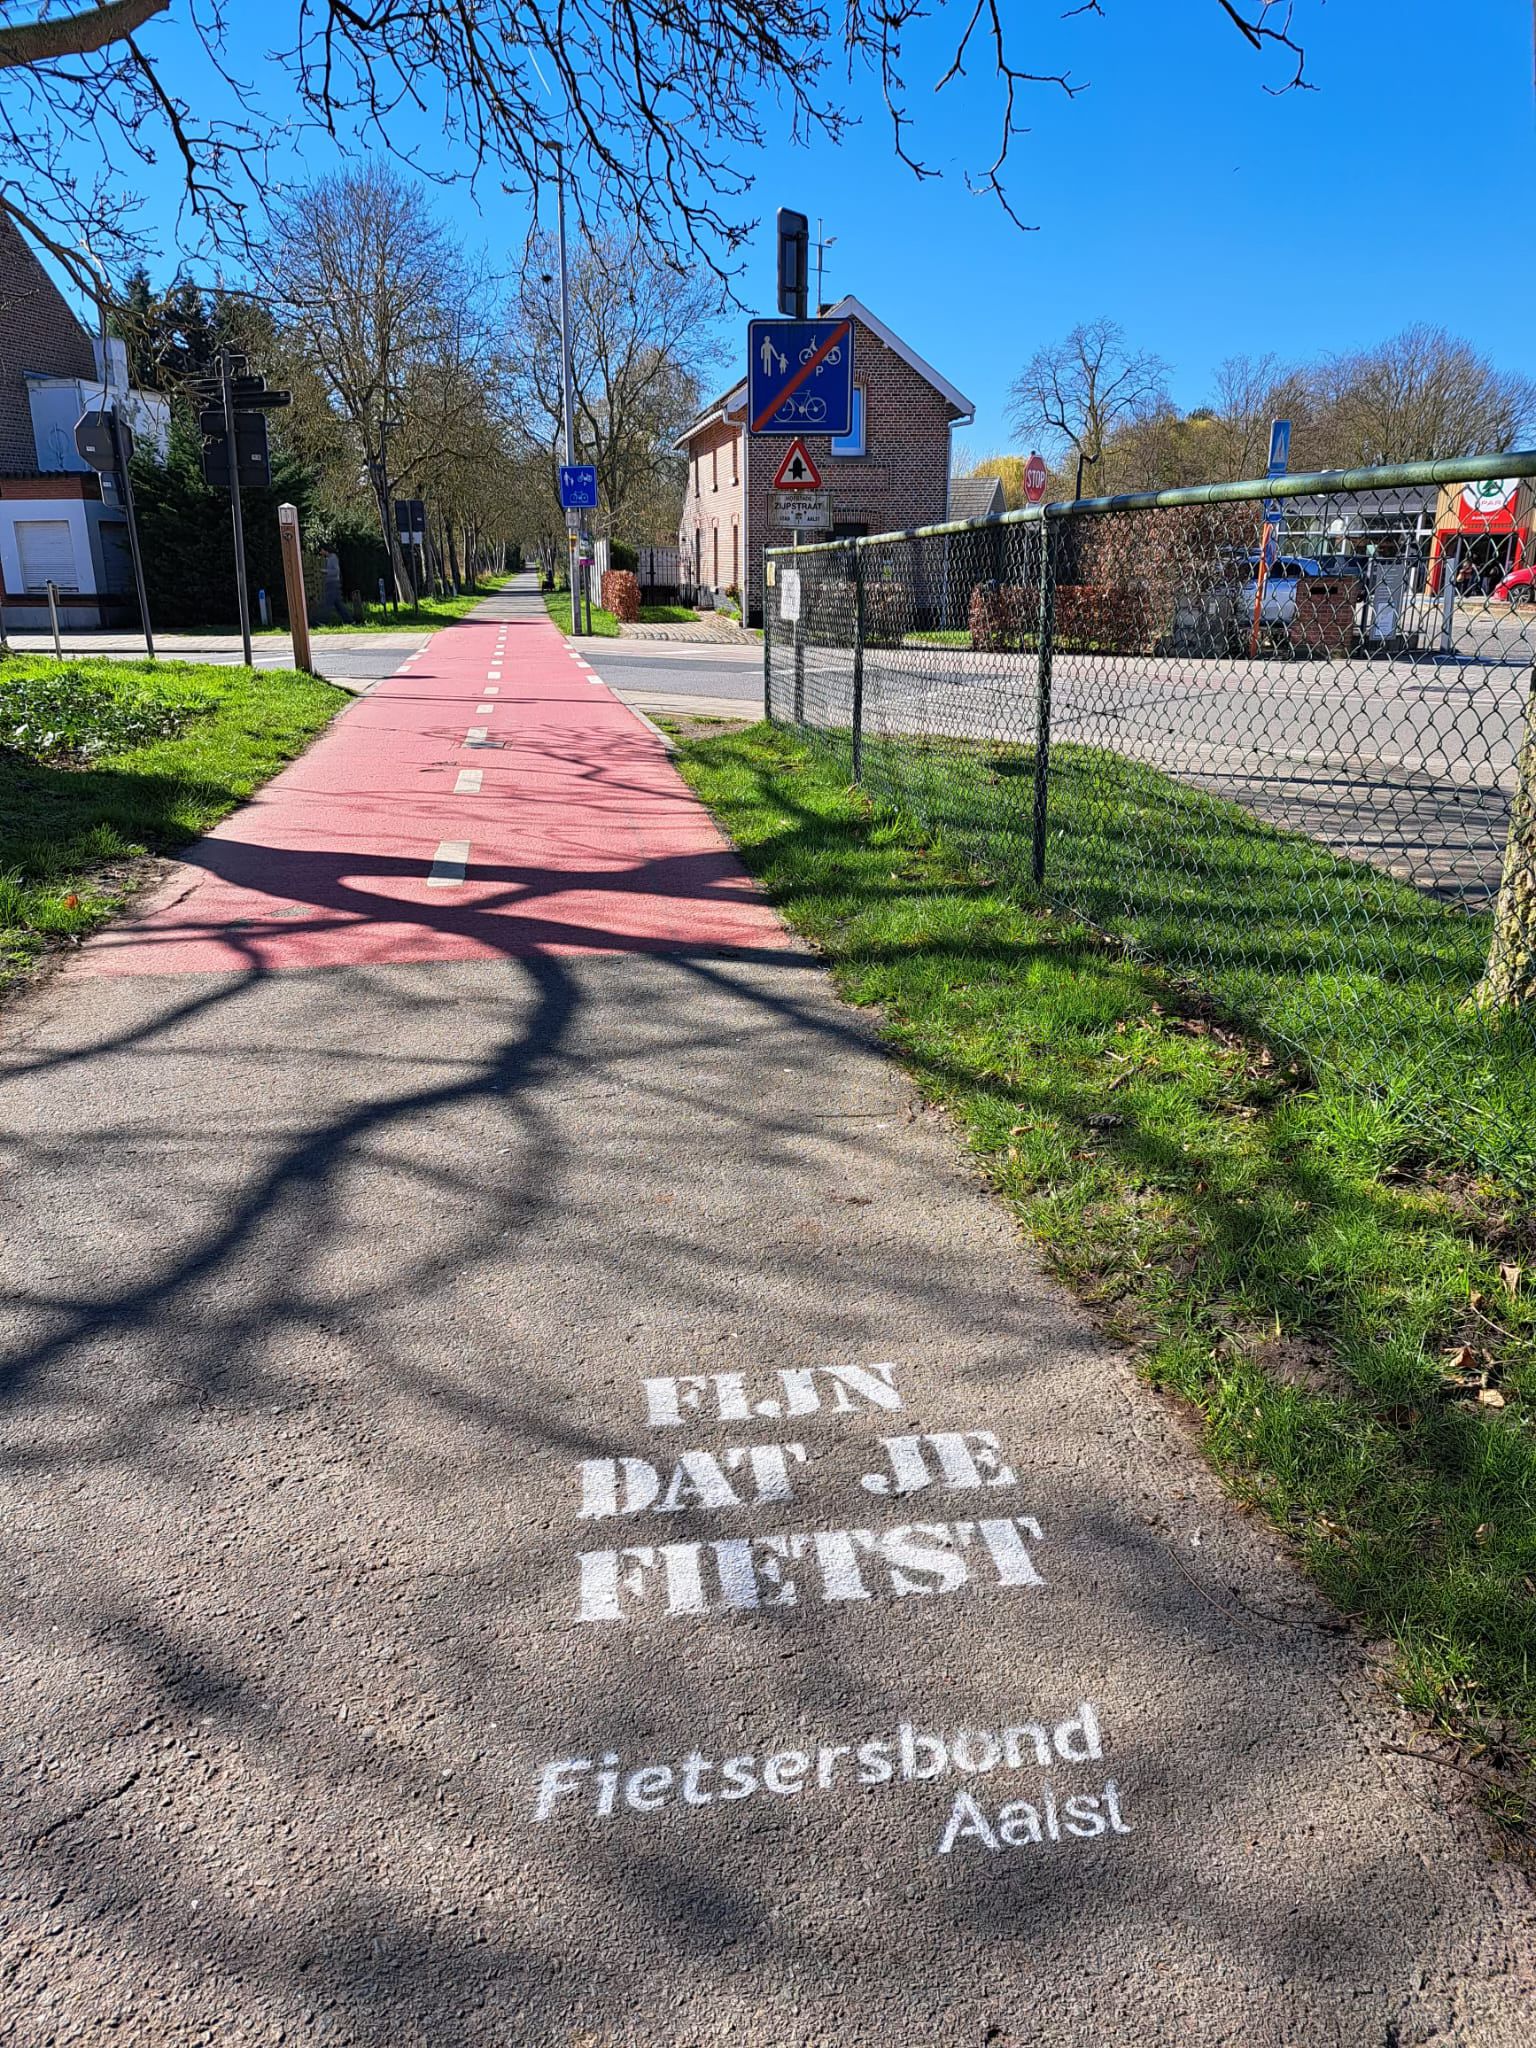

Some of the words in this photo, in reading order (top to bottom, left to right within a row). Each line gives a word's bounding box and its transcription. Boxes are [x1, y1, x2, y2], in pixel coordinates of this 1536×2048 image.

[816, 366, 824, 377] P
[774, 502, 823, 510] ZIJPSTRAAT
[1027, 469, 1045, 489] STOP
[643, 1362, 905, 1426] FIJN
[576, 1443, 807, 1519] DAT
[861, 1430, 1018, 1494] JE
[575, 1516, 1047, 1621] FIETST
[532, 1703, 1103, 1822] Fietsersbond
[937, 1779, 1132, 1854] Aalst
